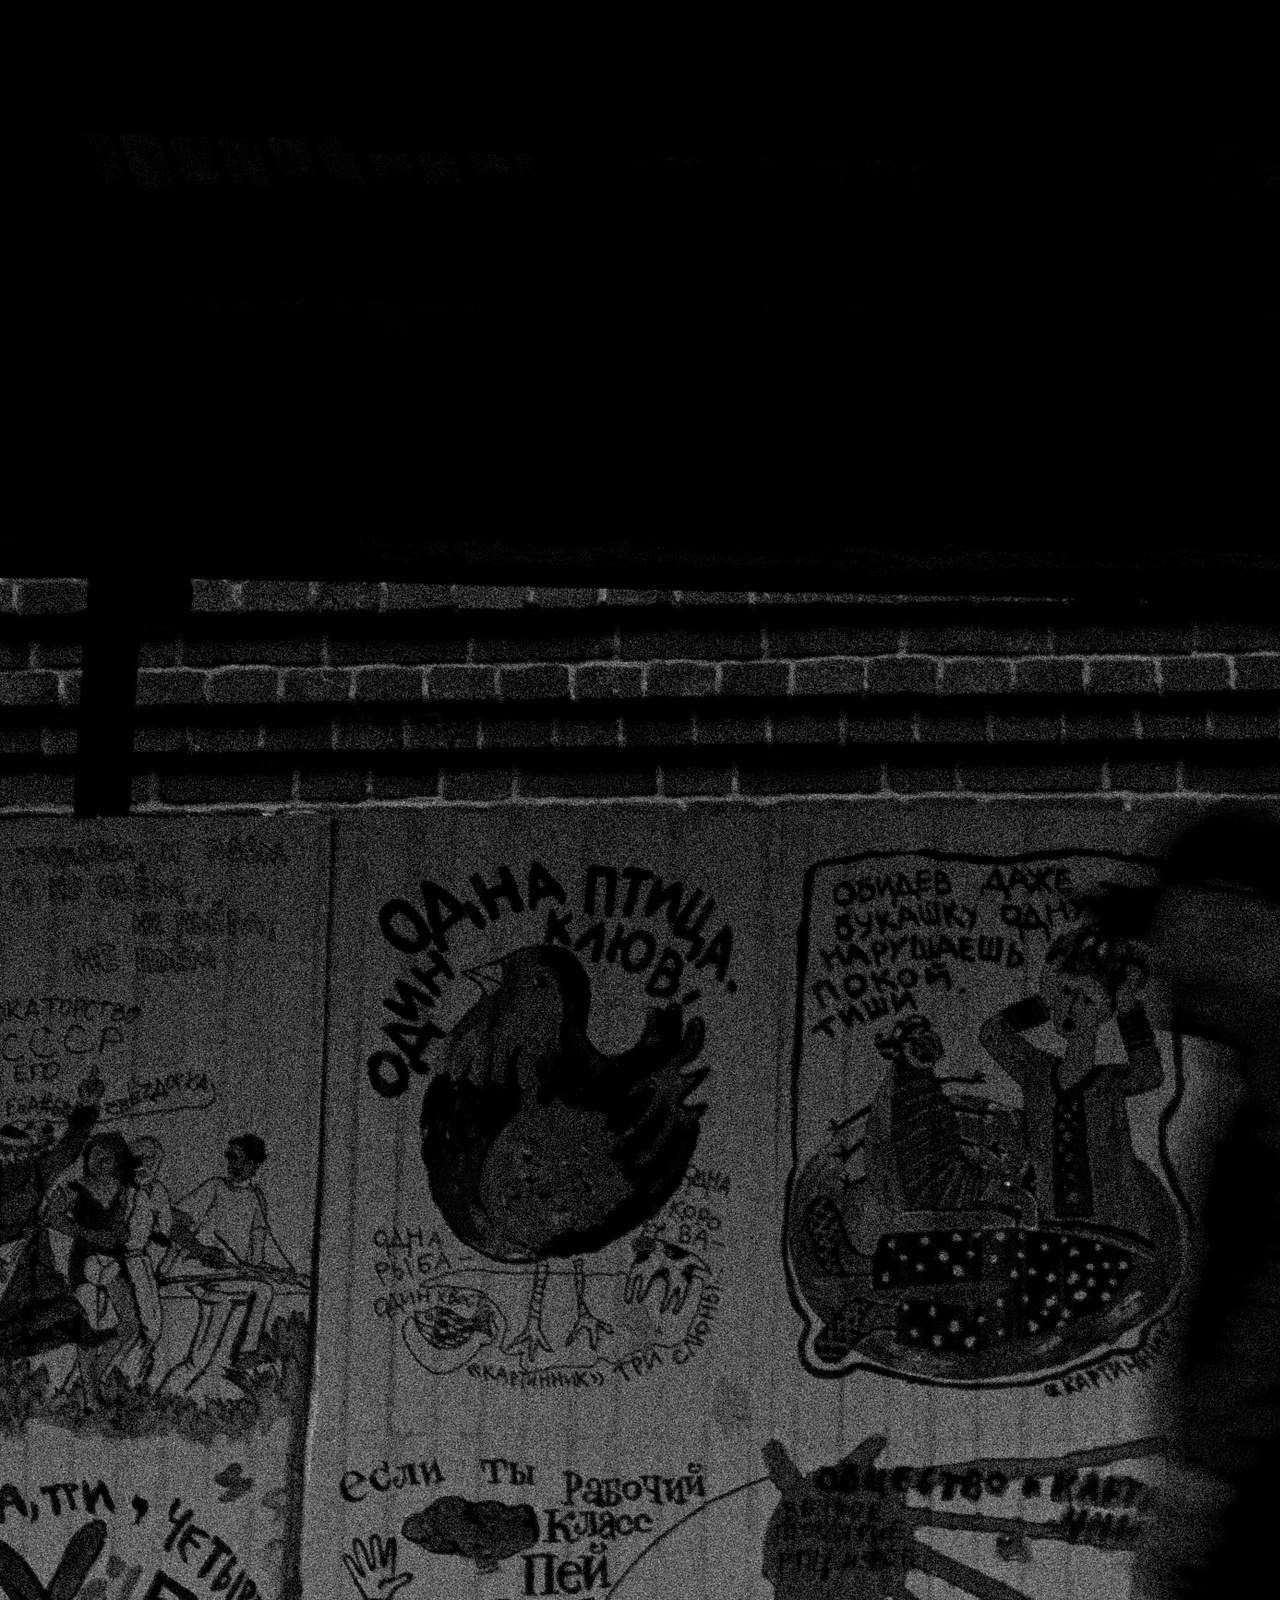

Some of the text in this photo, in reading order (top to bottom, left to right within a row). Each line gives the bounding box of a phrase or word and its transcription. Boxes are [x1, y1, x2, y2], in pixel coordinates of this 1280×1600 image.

[378, 862, 566, 955] ОДНА
[832, 867, 1073, 907] ОБИДЕВ ДАЖЕ
[835, 900, 978, 942] БУКАШКУ
[367, 950, 455, 1099] ОДИН
